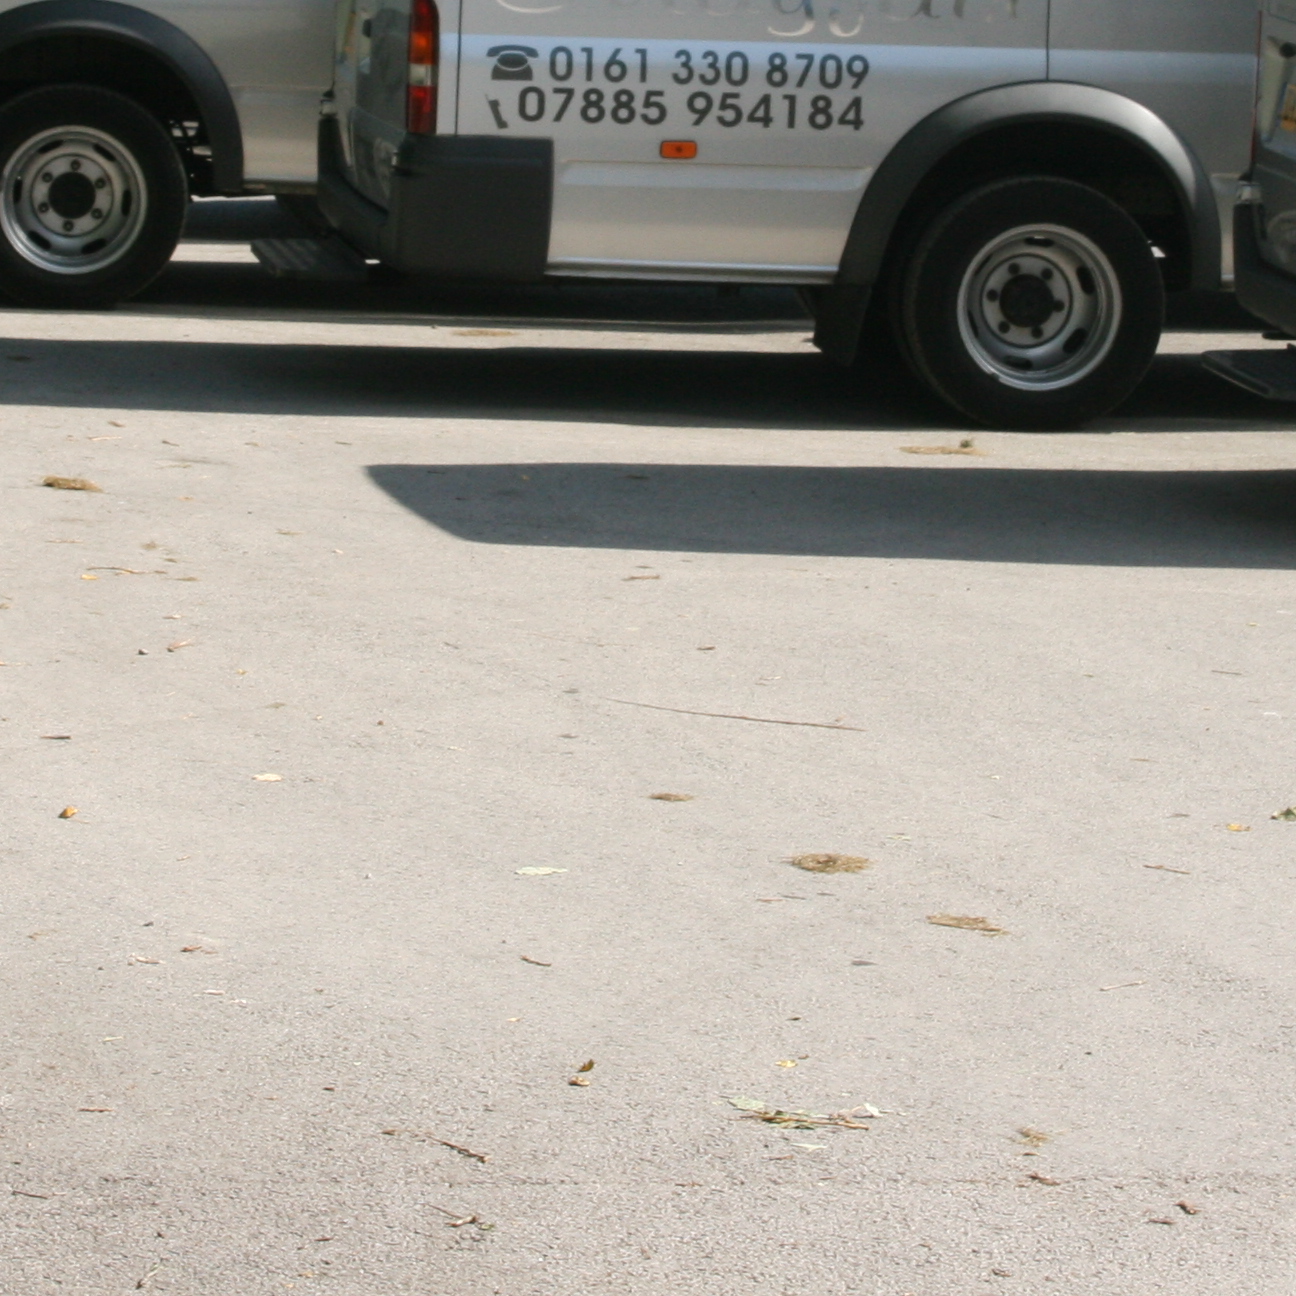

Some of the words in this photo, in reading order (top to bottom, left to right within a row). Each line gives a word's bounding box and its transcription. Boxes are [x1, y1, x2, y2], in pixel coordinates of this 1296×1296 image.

[548, 46, 649, 84] 0161
[671, 50, 750, 87] 330
[765, 53, 870, 91] 8709
[517, 85, 667, 126] 07885
[686, 90, 864, 131] 954184
